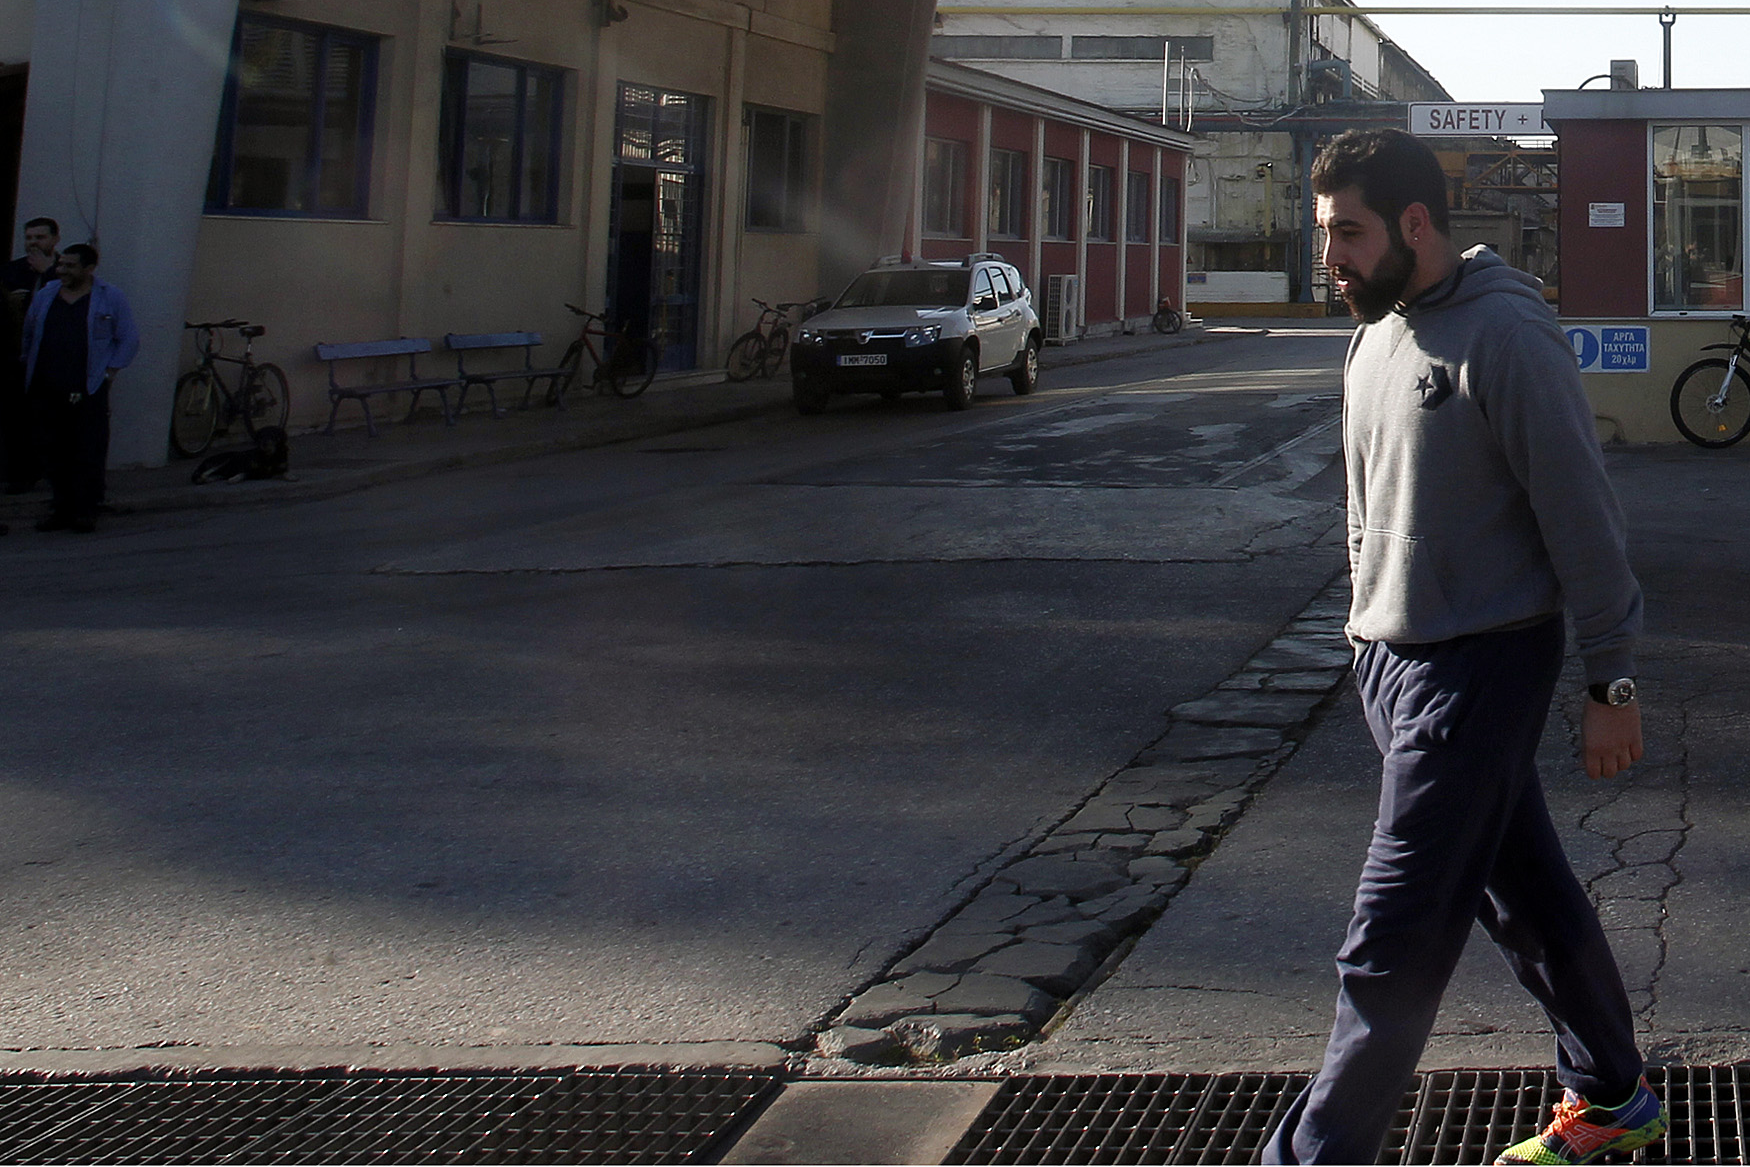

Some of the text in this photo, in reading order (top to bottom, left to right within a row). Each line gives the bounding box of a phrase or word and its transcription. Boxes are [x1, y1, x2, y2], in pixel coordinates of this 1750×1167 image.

[1430, 109, 1506, 130] SAFETY
[1613, 332, 1635, 342] ΑΡΓΑ
[1603, 343, 1645, 353] ΤΑΧΥΤΗΤΑ
